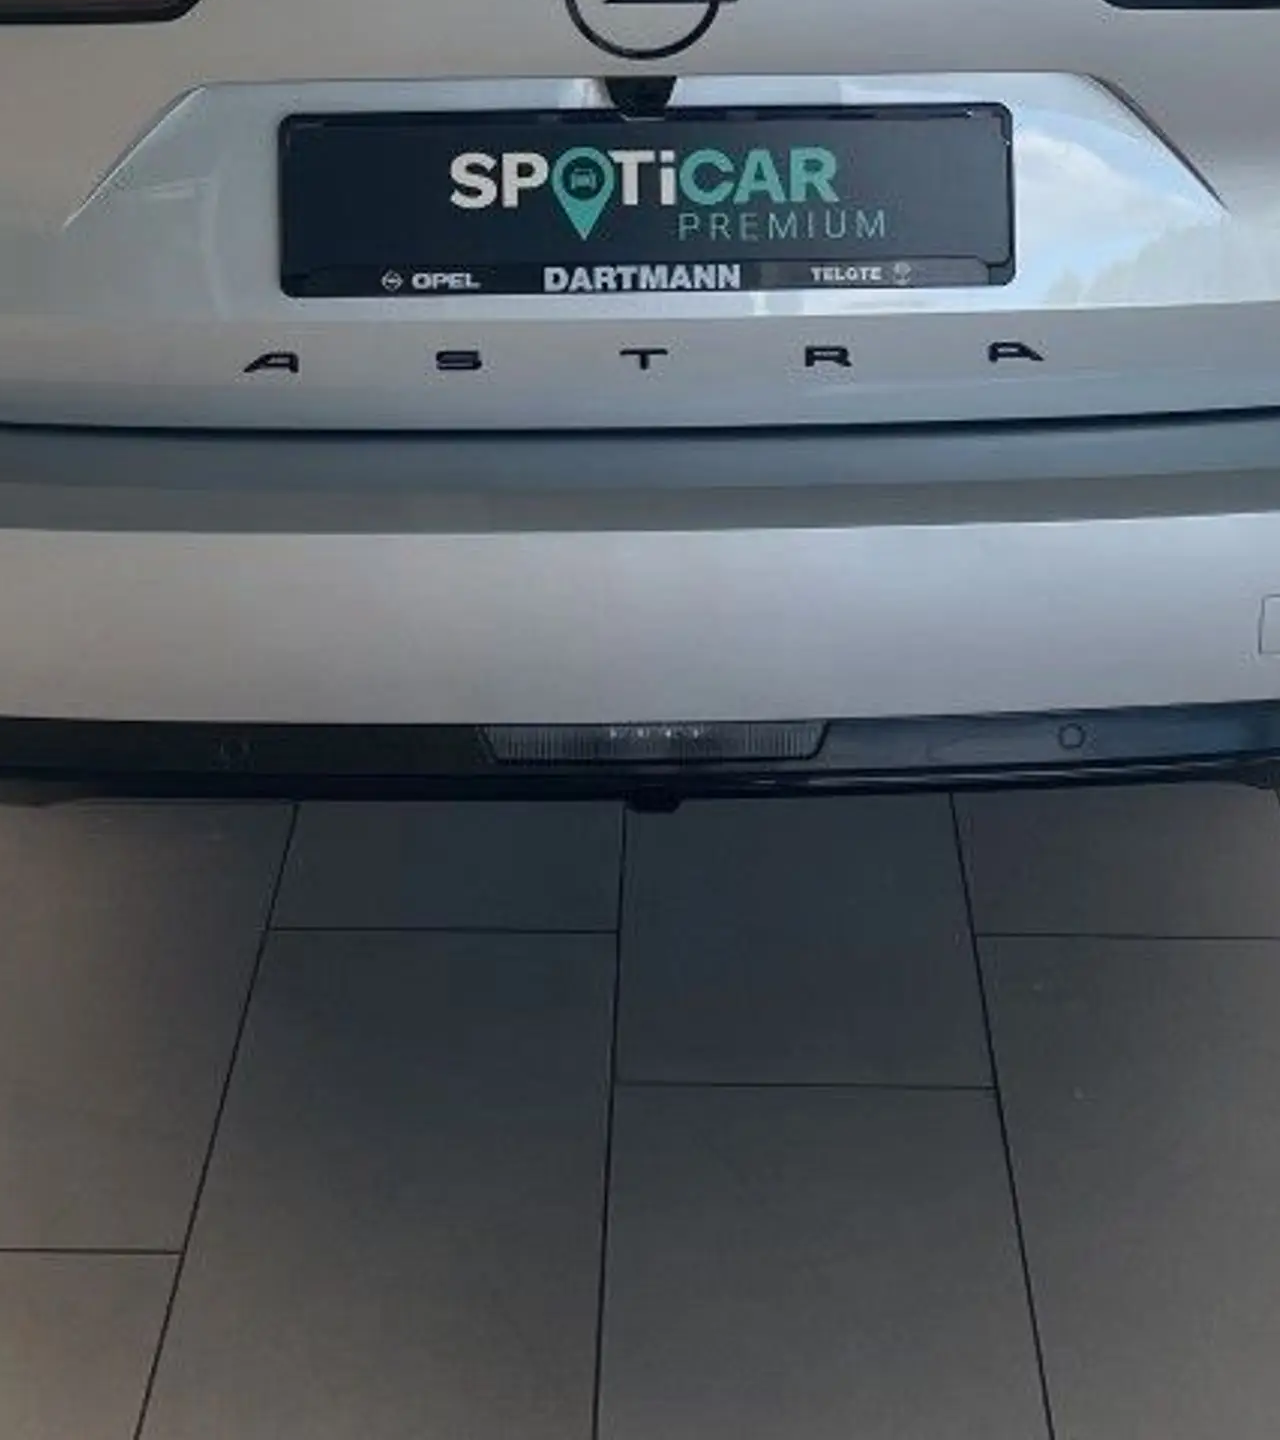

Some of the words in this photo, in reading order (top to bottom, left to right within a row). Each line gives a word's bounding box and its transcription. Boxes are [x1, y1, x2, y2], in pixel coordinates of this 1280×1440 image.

[678, 209, 887, 241] PREMIUM
[411, 272, 482, 290] OPEL
[543, 264, 741, 293] DARTMANN
[243, 340, 1046, 373] ASTRA
